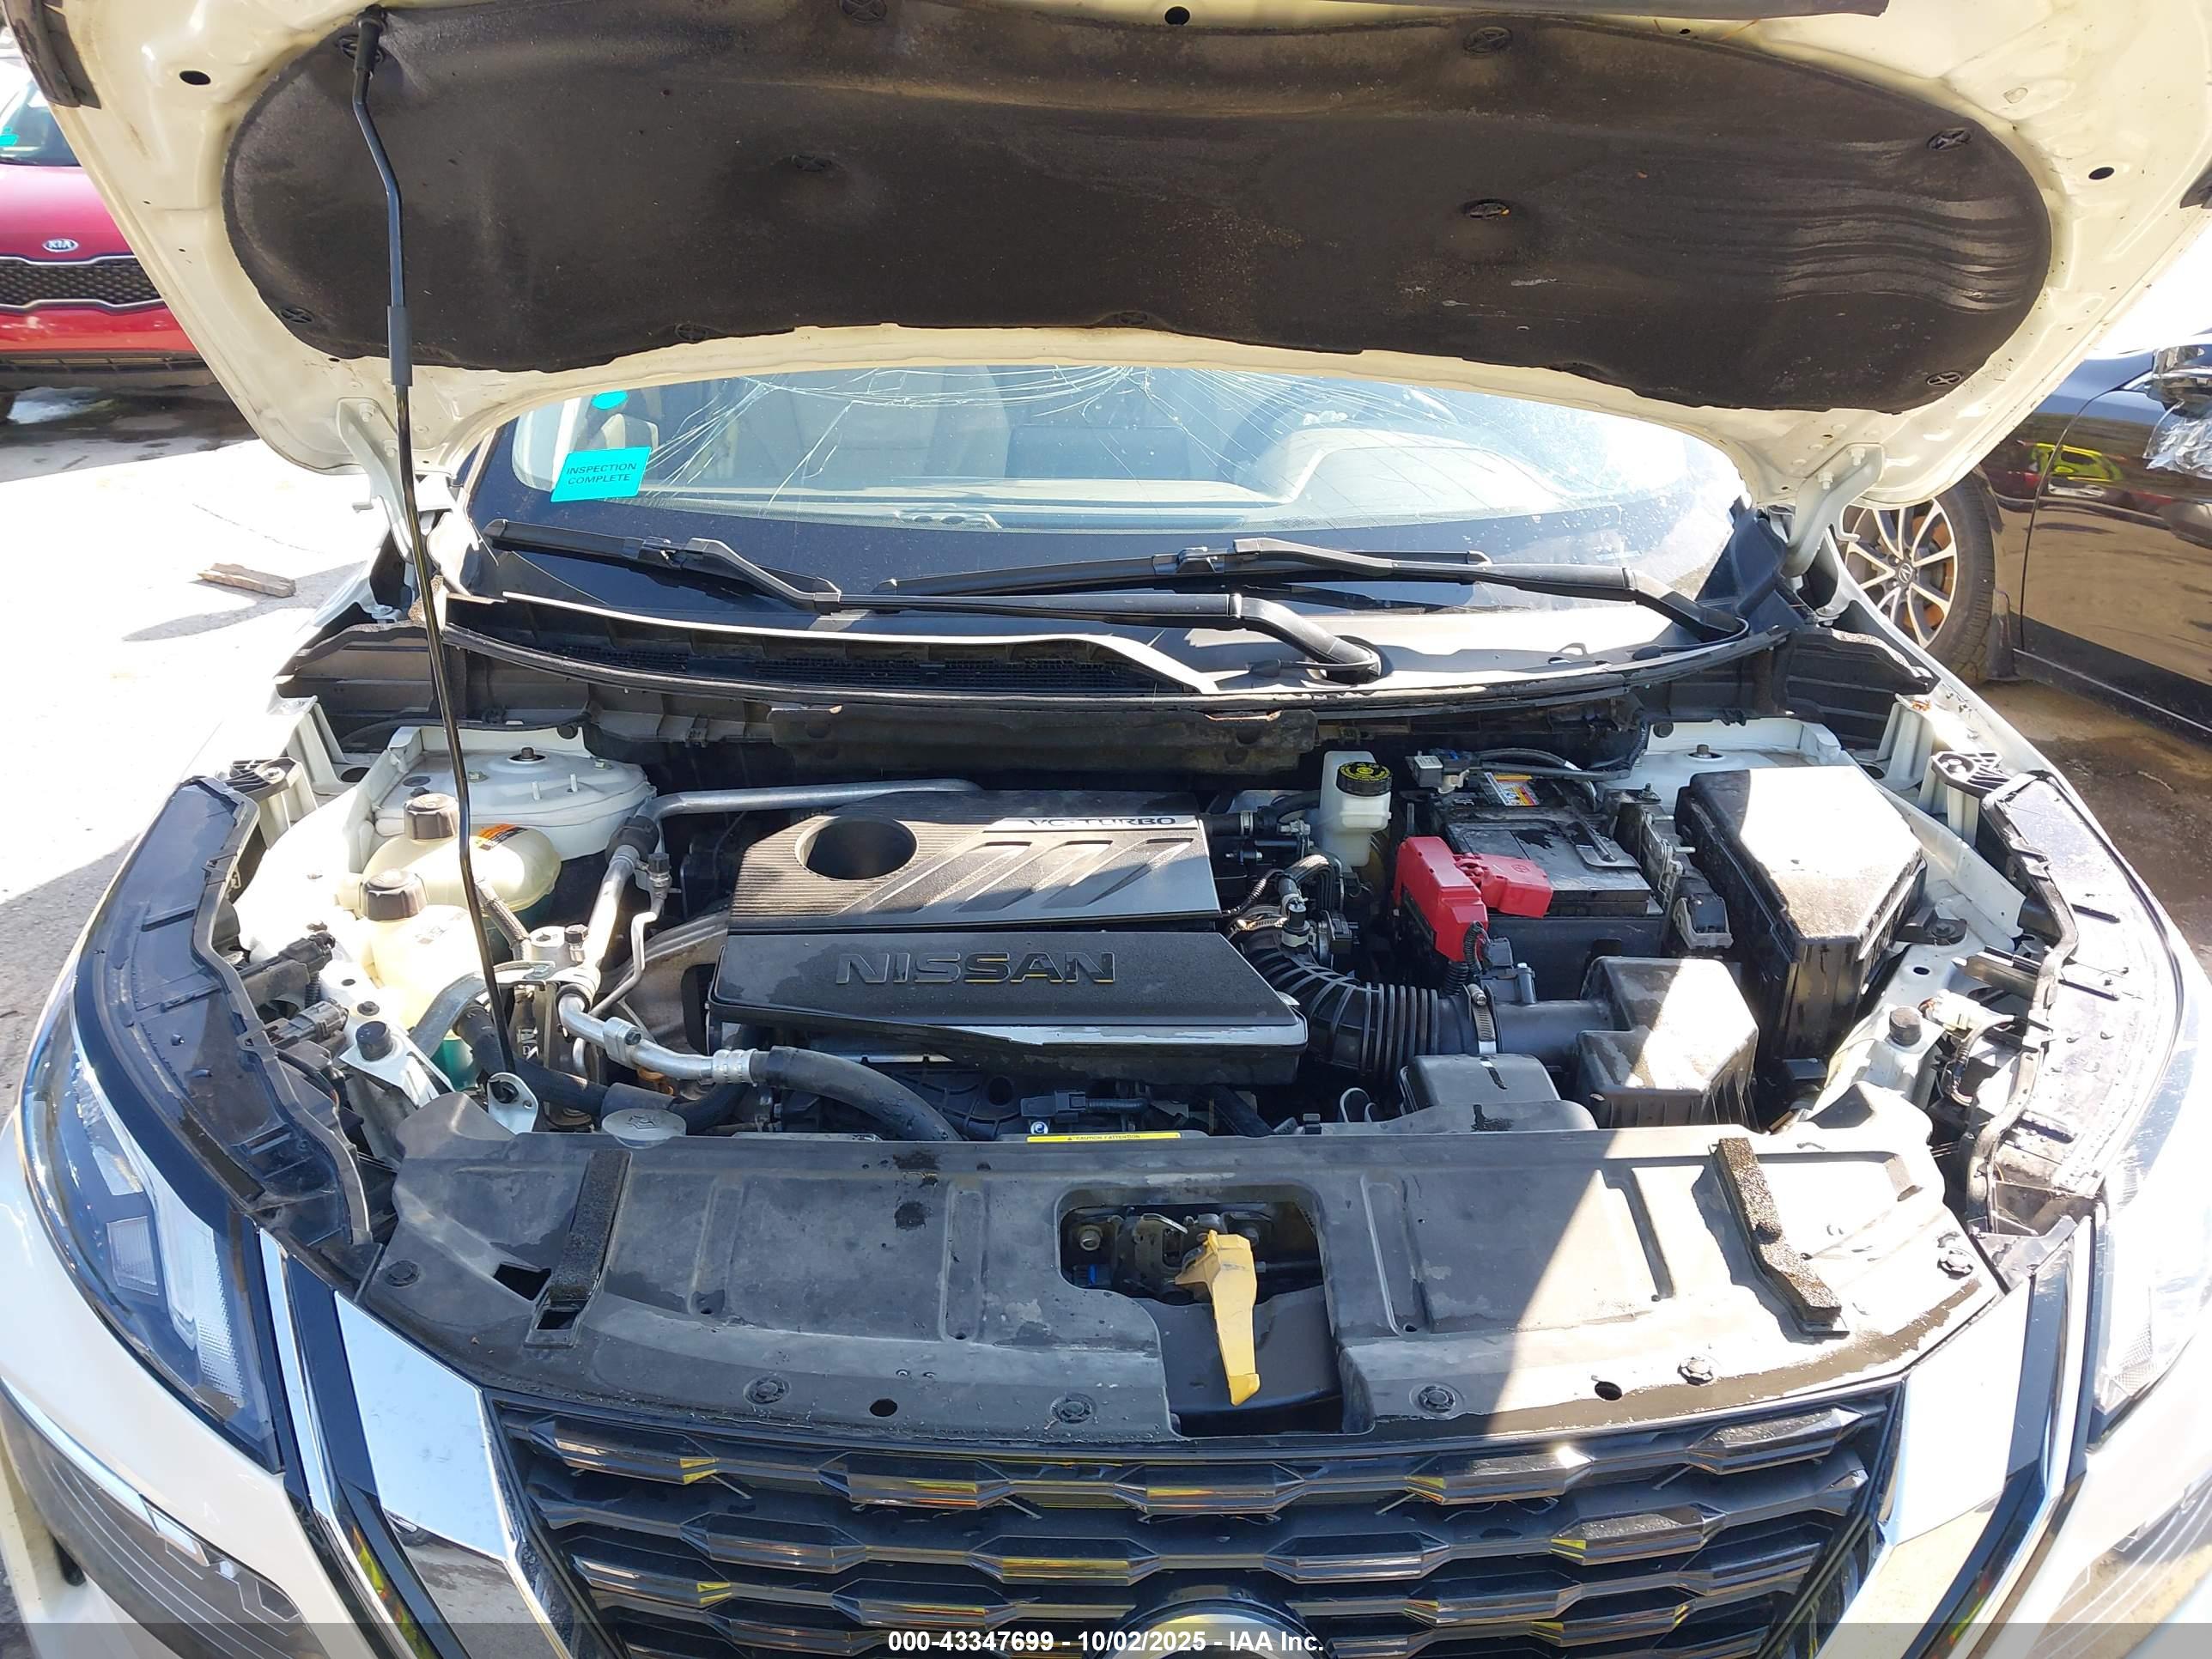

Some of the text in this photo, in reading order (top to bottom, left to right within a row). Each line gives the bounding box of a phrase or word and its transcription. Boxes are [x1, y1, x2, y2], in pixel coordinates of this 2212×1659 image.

[48, 240, 72, 249] KIA
[567, 464, 636, 474] INSPECTION
[568, 474, 630, 484] COMPLETE
[836, 951, 1115, 985] NISSAN
